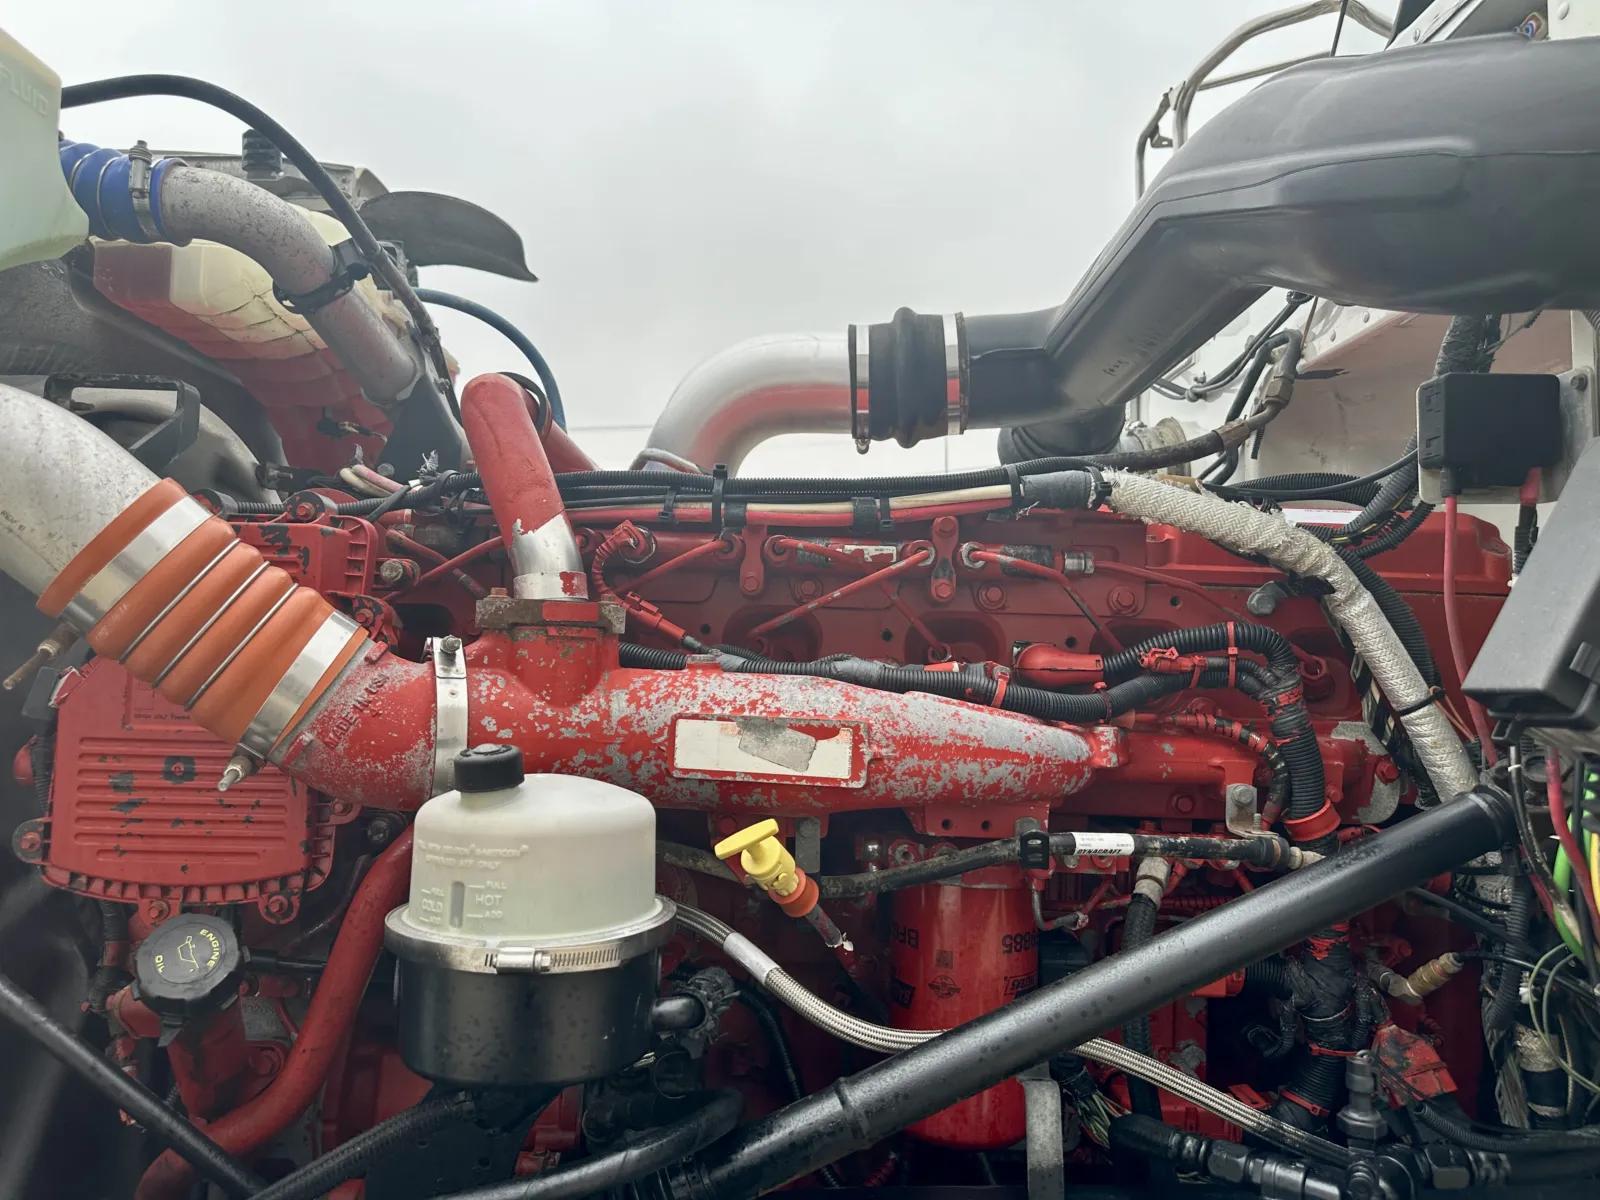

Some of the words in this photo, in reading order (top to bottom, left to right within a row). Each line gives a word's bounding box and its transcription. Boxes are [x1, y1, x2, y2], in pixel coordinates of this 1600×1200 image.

[322, 710, 359, 750] MADE
[475, 894, 503, 906] HOT
[200, 929, 220, 968] ENGINE
[155, 955, 165, 973] OIL
